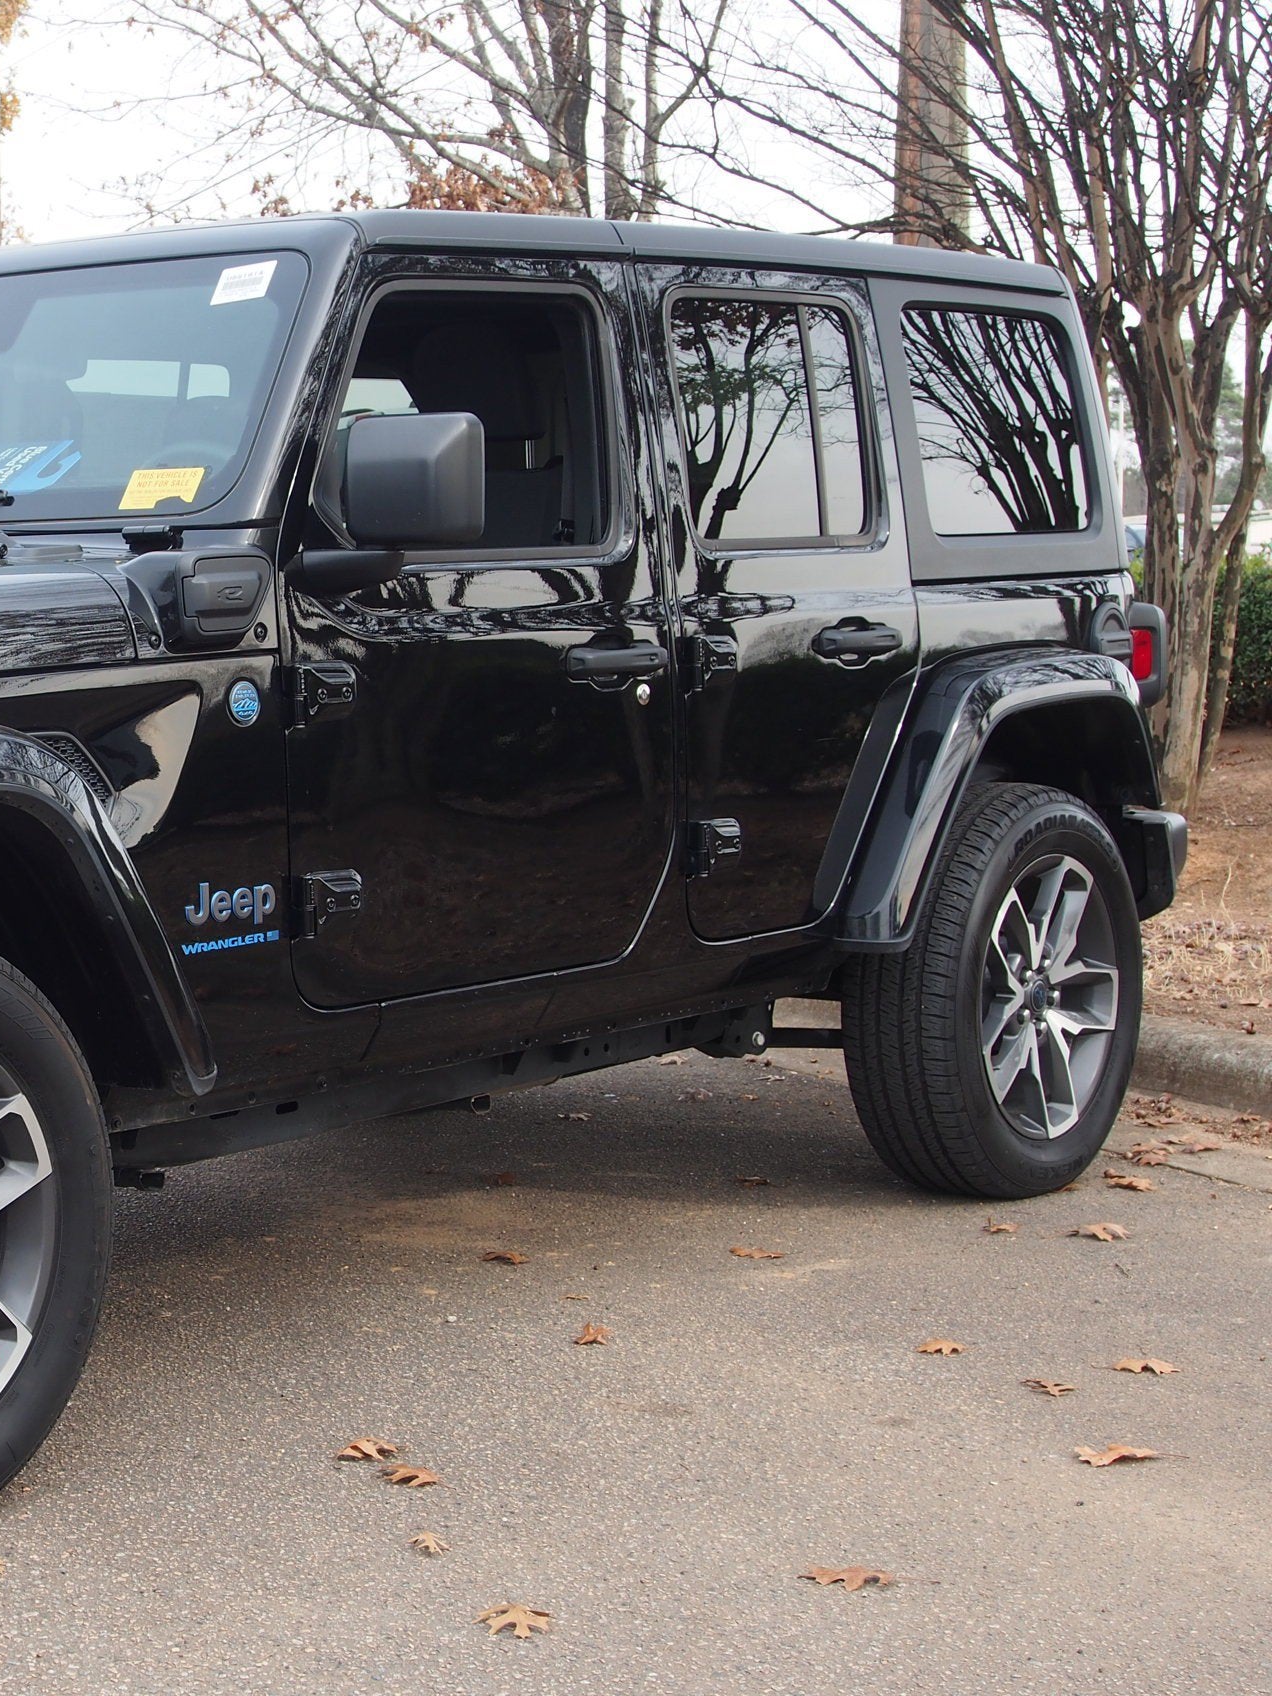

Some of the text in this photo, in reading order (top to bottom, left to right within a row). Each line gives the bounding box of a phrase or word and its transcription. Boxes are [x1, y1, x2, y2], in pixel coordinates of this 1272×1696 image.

[19, 446, 47, 463] Blue
[136, 480, 152, 488] NOT
[170, 480, 190, 488] SALE
[137, 471, 155, 480] THIS
[156, 471, 187, 479] VEHICLE
[184, 882, 276, 926] Jeep
[181, 932, 265, 956] WRANGLER
